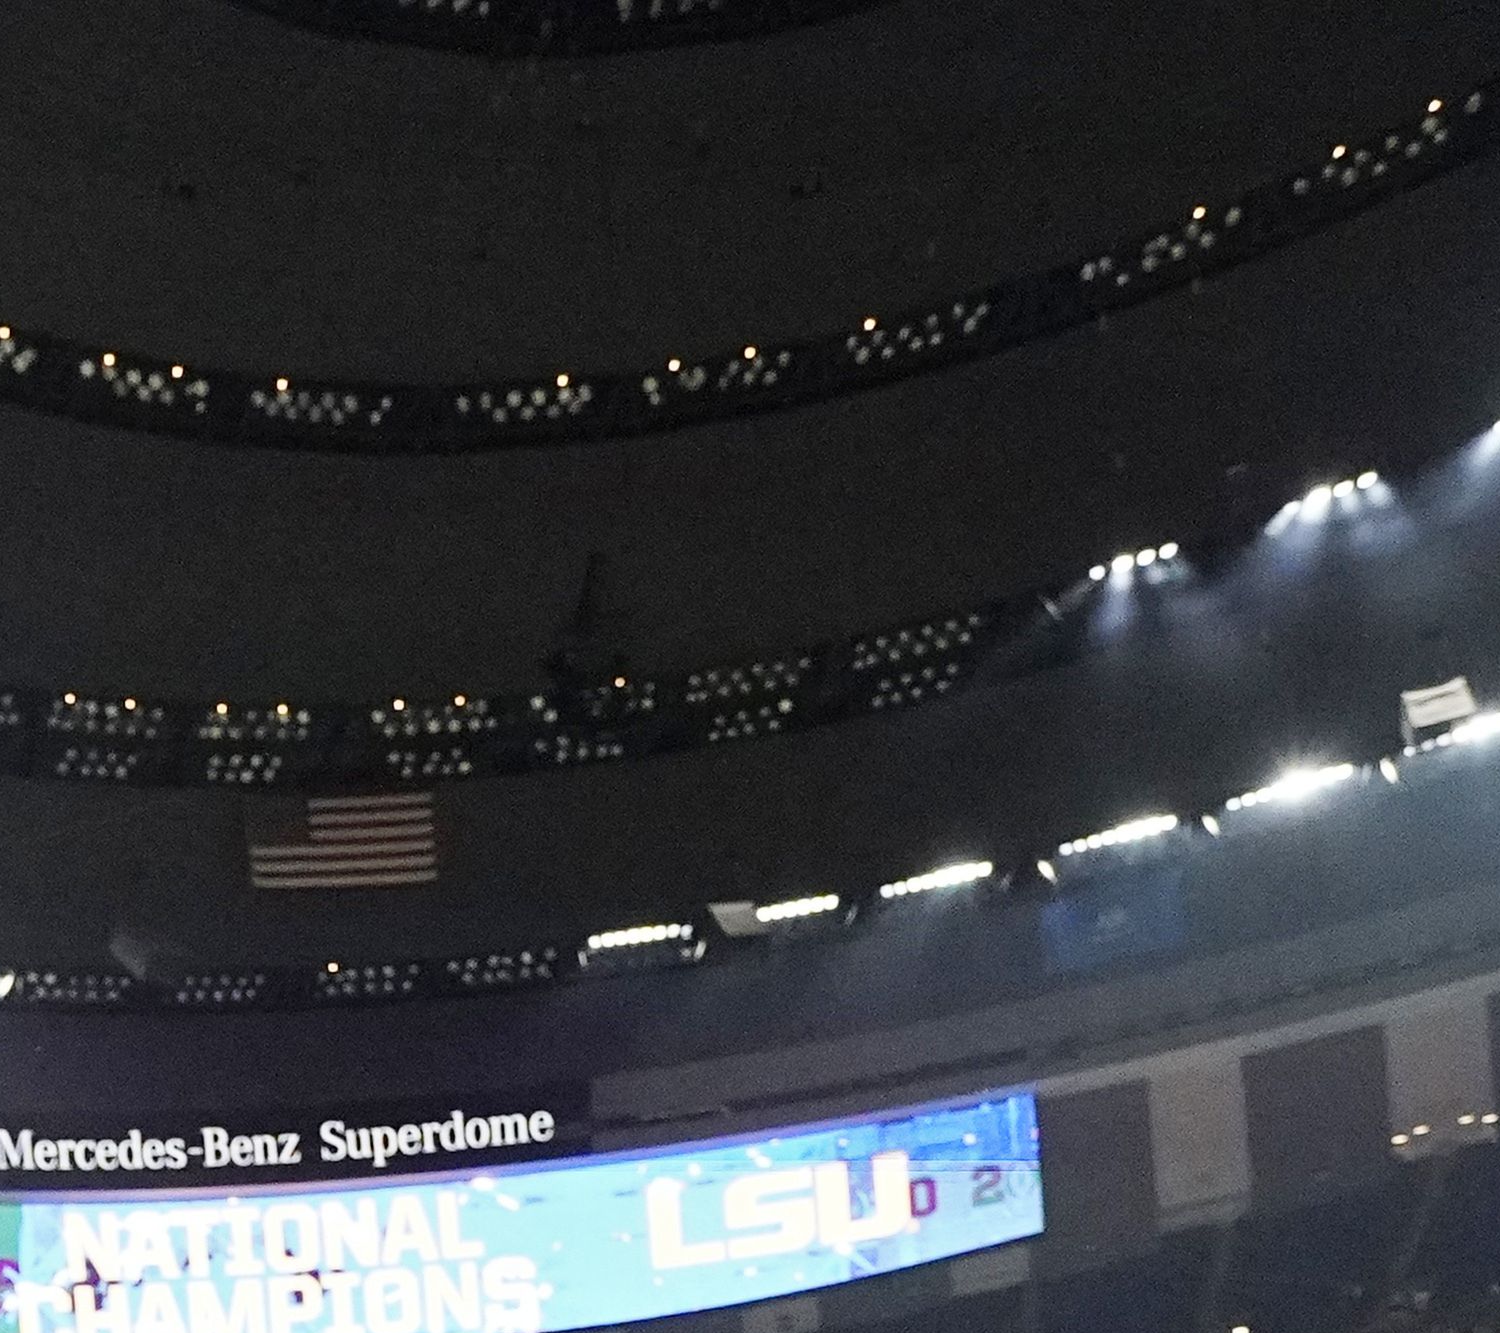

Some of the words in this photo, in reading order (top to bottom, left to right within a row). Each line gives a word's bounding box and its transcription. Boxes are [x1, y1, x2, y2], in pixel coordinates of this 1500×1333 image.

[319, 1108, 555, 1167] Superdome
[62, 1192, 486, 1283] NATIONAL
[645, 1150, 909, 1271] LSU
